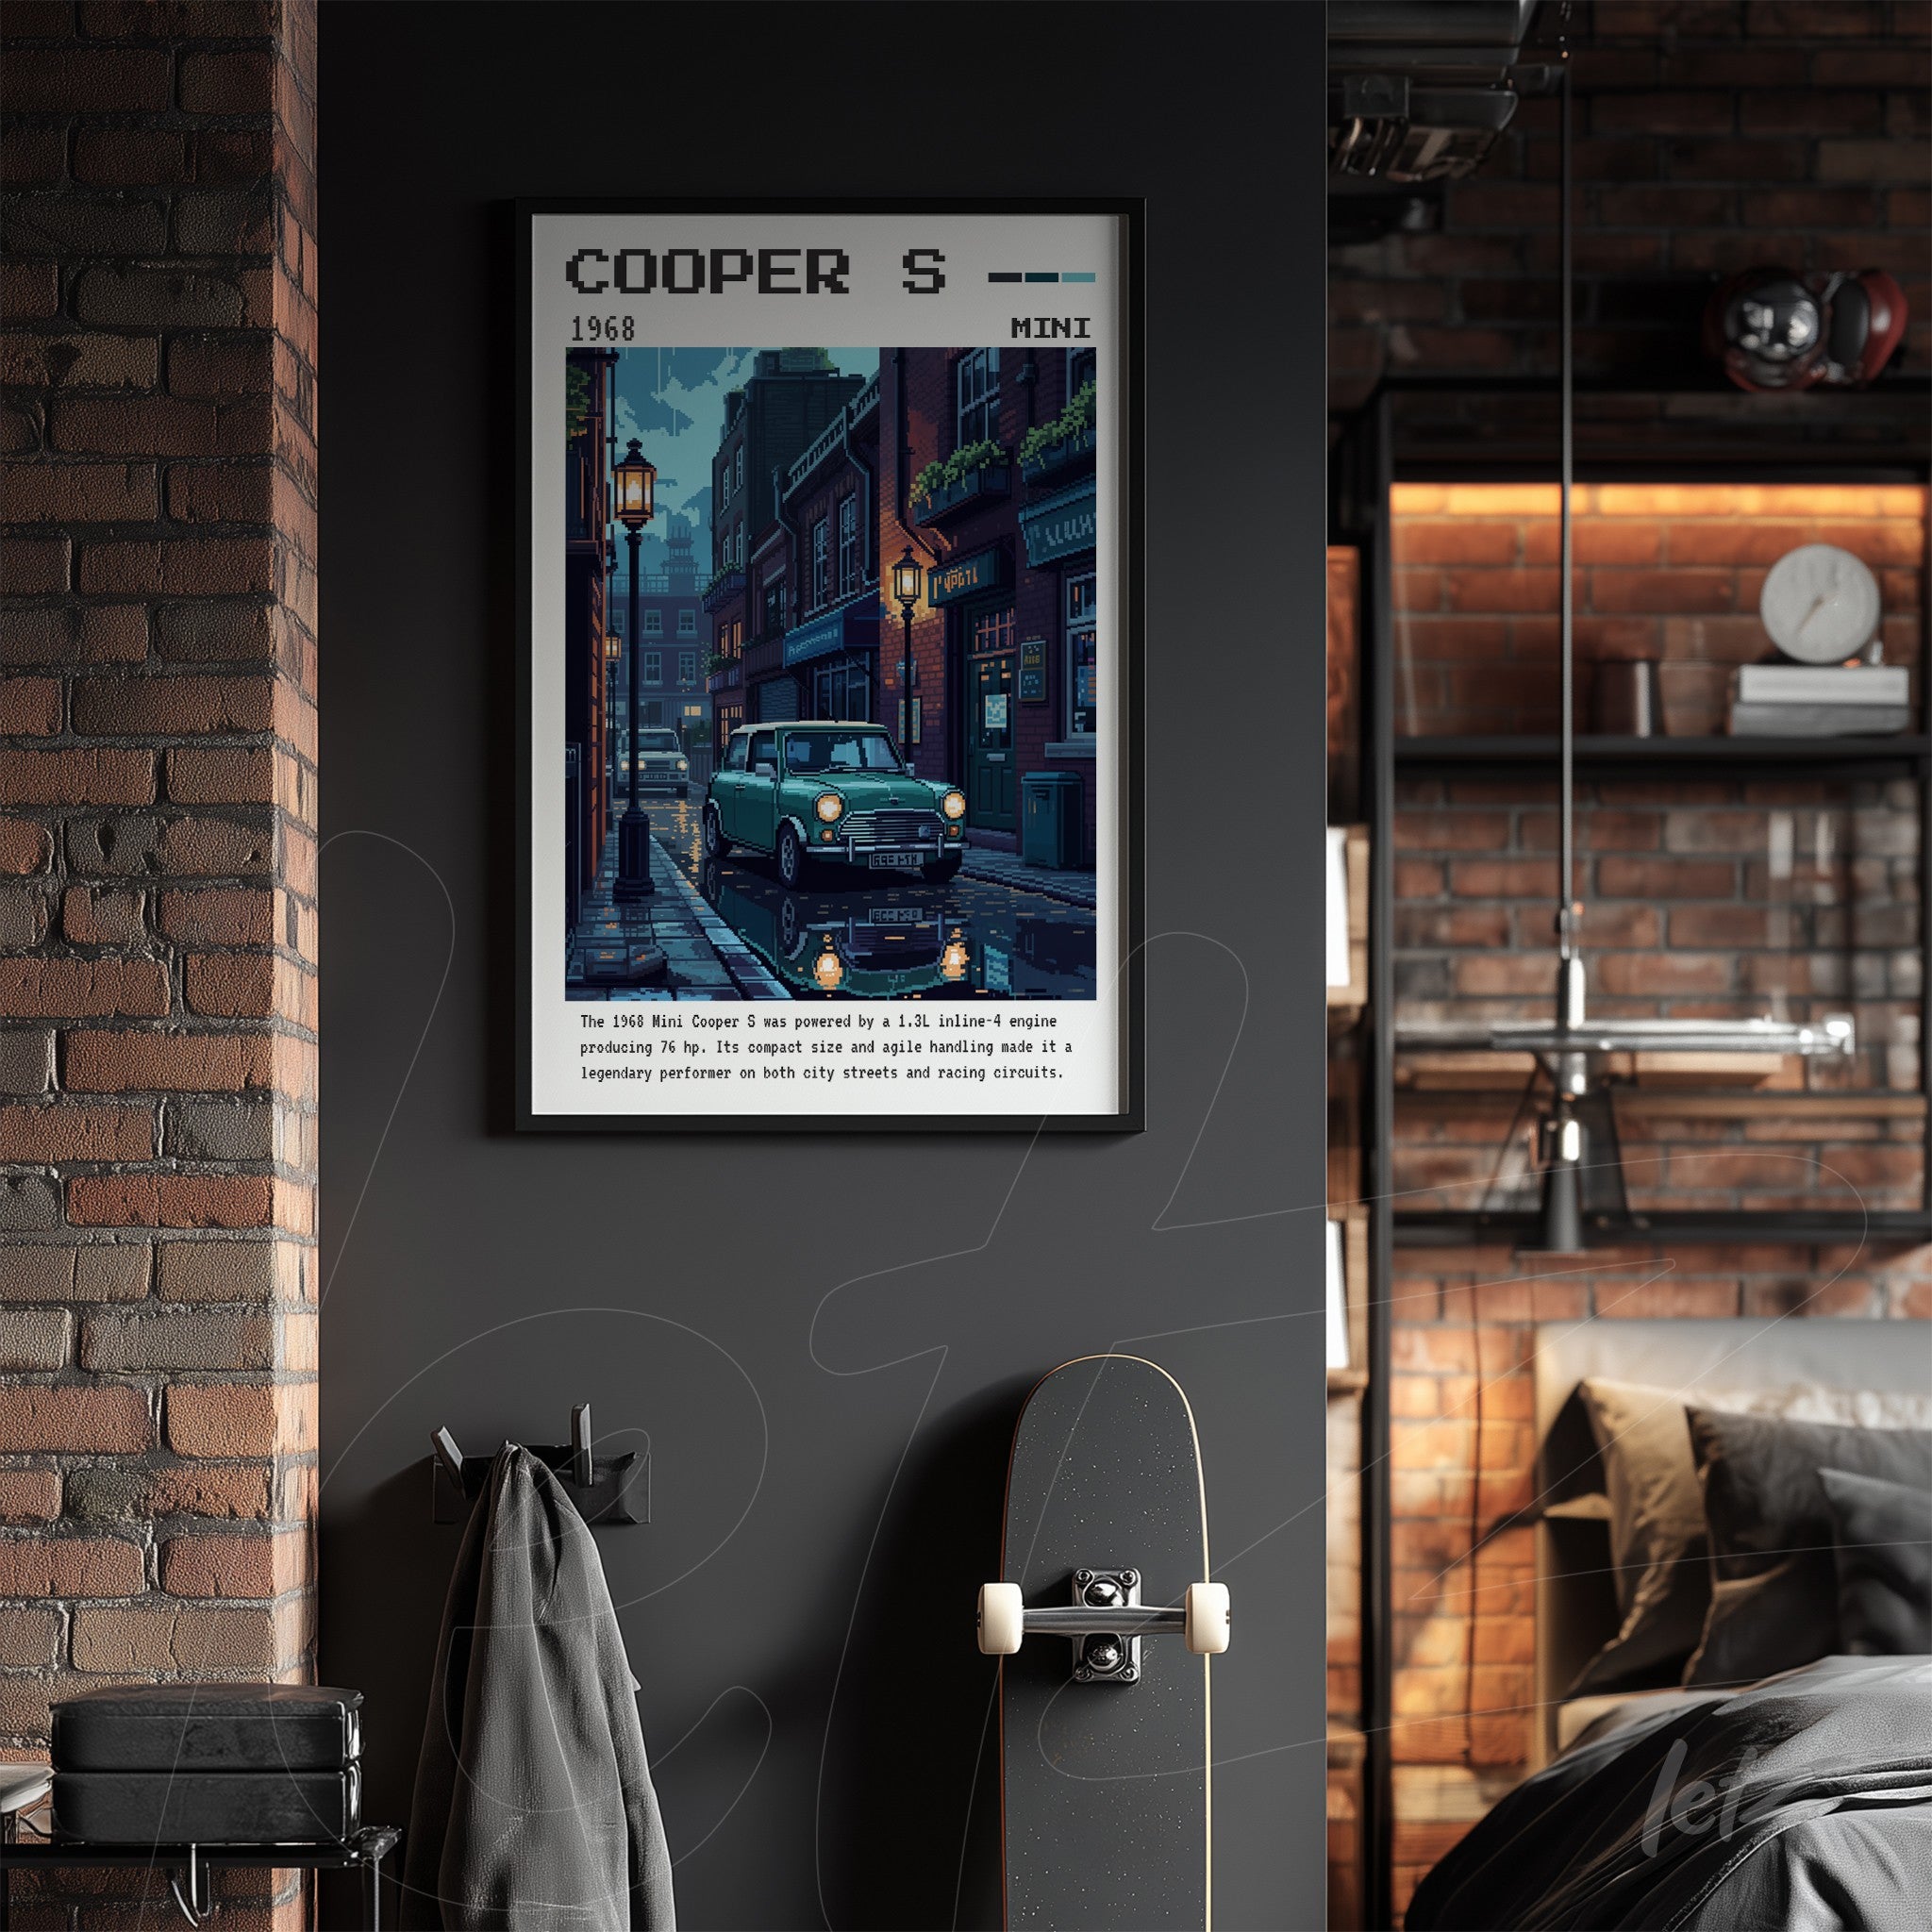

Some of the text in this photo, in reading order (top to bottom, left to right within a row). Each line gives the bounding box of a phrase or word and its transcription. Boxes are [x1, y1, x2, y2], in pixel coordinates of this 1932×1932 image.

[565, 248, 946, 294] COOPER S
[572, 315, 635, 341] 1968
[1010, 317, 1091, 339] MINI
[580, 1013, 1058, 1031] The 1968 Mini Cooper S was powered by a 1.3L inline-4 engine
[580, 1040, 1073, 1058] producing 76 hp. Its compact size and agile handling made it a
[581, 1065, 1062, 1083] legendary performer on both city streets and racing circuits.
